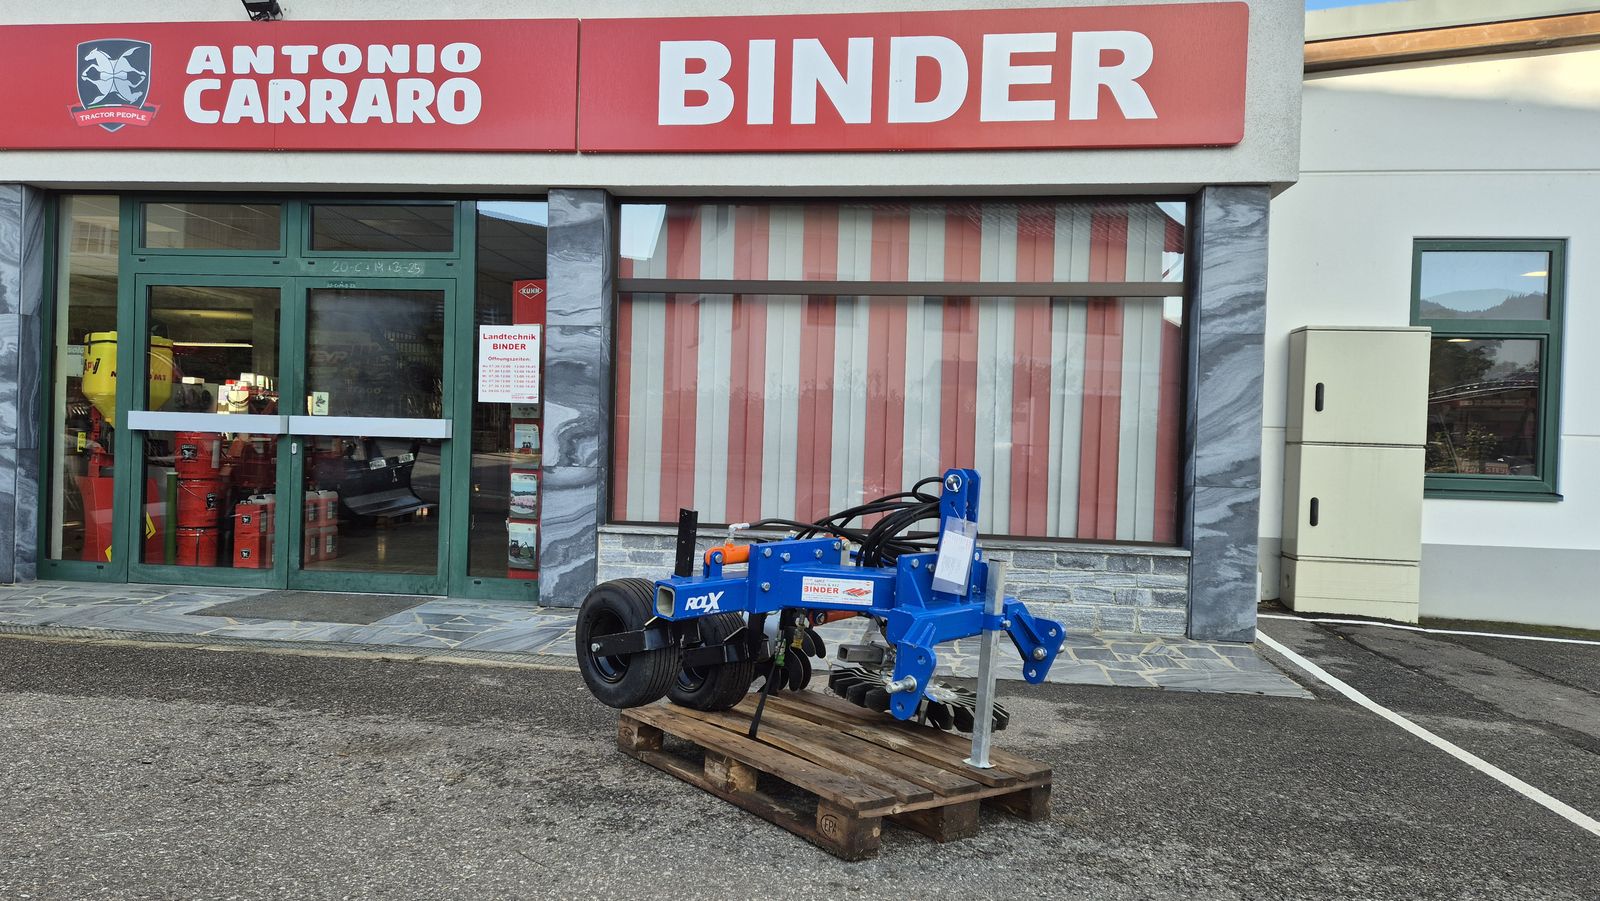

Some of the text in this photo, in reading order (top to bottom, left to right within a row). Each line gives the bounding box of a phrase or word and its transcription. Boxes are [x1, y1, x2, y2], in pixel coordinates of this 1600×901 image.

[185, 42, 482, 75] ANTONIO
[657, 30, 1159, 126] BINDER
[79, 111, 146, 121] TRACTOR PEOPLE
[183, 77, 482, 125] CARRARO
[804, 585, 839, 594] BINDER
